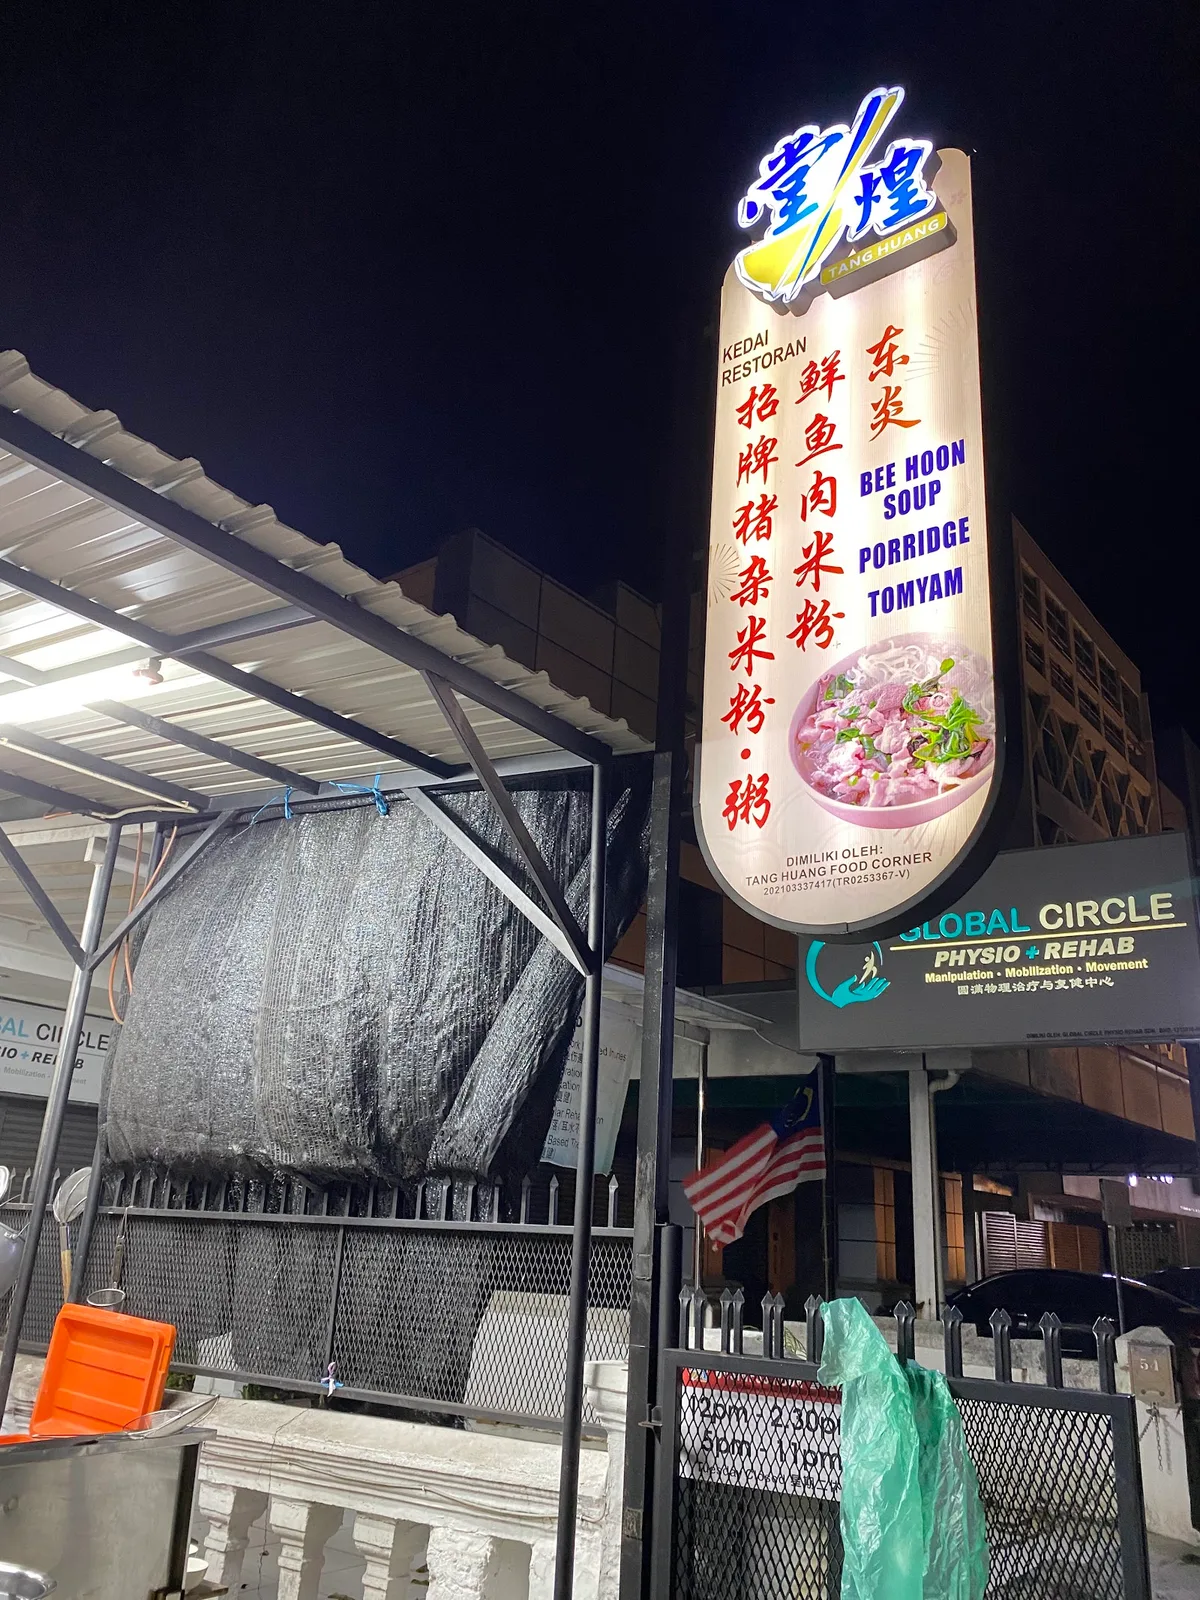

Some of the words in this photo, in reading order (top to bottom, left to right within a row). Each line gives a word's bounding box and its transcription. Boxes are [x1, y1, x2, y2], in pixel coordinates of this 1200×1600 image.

[829, 250, 873, 279] TANG
[877, 218, 940, 257] HUANG
[720, 336, 807, 388] RESTORAN
[721, 329, 770, 364] KEDAI
[865, 324, 922, 443] 东炎
[859, 462, 896, 498] BEE
[905, 438, 966, 482] HOON
[785, 349, 846, 653] 鲜鱼肉米粉
[883, 479, 942, 520] SOUP
[858, 516, 971, 574] PORRIDGE
[867, 566, 964, 618] TOMYAM
[746, 872, 778, 887] TANG
[781, 866, 827, 882] HUANG
[830, 860, 868, 876] FOOD
[871, 851, 933, 870] CORNER
[786, 850, 838, 867] DIMILIKI
[841, 844, 883, 859] OLEH:
[1039, 892, 1176, 931] CIRCLE
[924, 968, 995, 985] Manipulation
[1004, 963, 1075, 979] Mobilization
[1085, 957, 1149, 974] Movement
[934, 944, 1022, 969] PHYSIO
[1043, 936, 1136, 961] REHAB
[0, 1016, 30, 1039] AL
[36, 1023, 111, 1051] CILE
[0, 1046, 18, 1060] IO
[31, 1051, 84, 1070] REB
[690, 1393, 749, 1424] 12pm
[770, 1404, 842, 1439] 2.30p
[701, 1428, 751, 1459] 5pm
